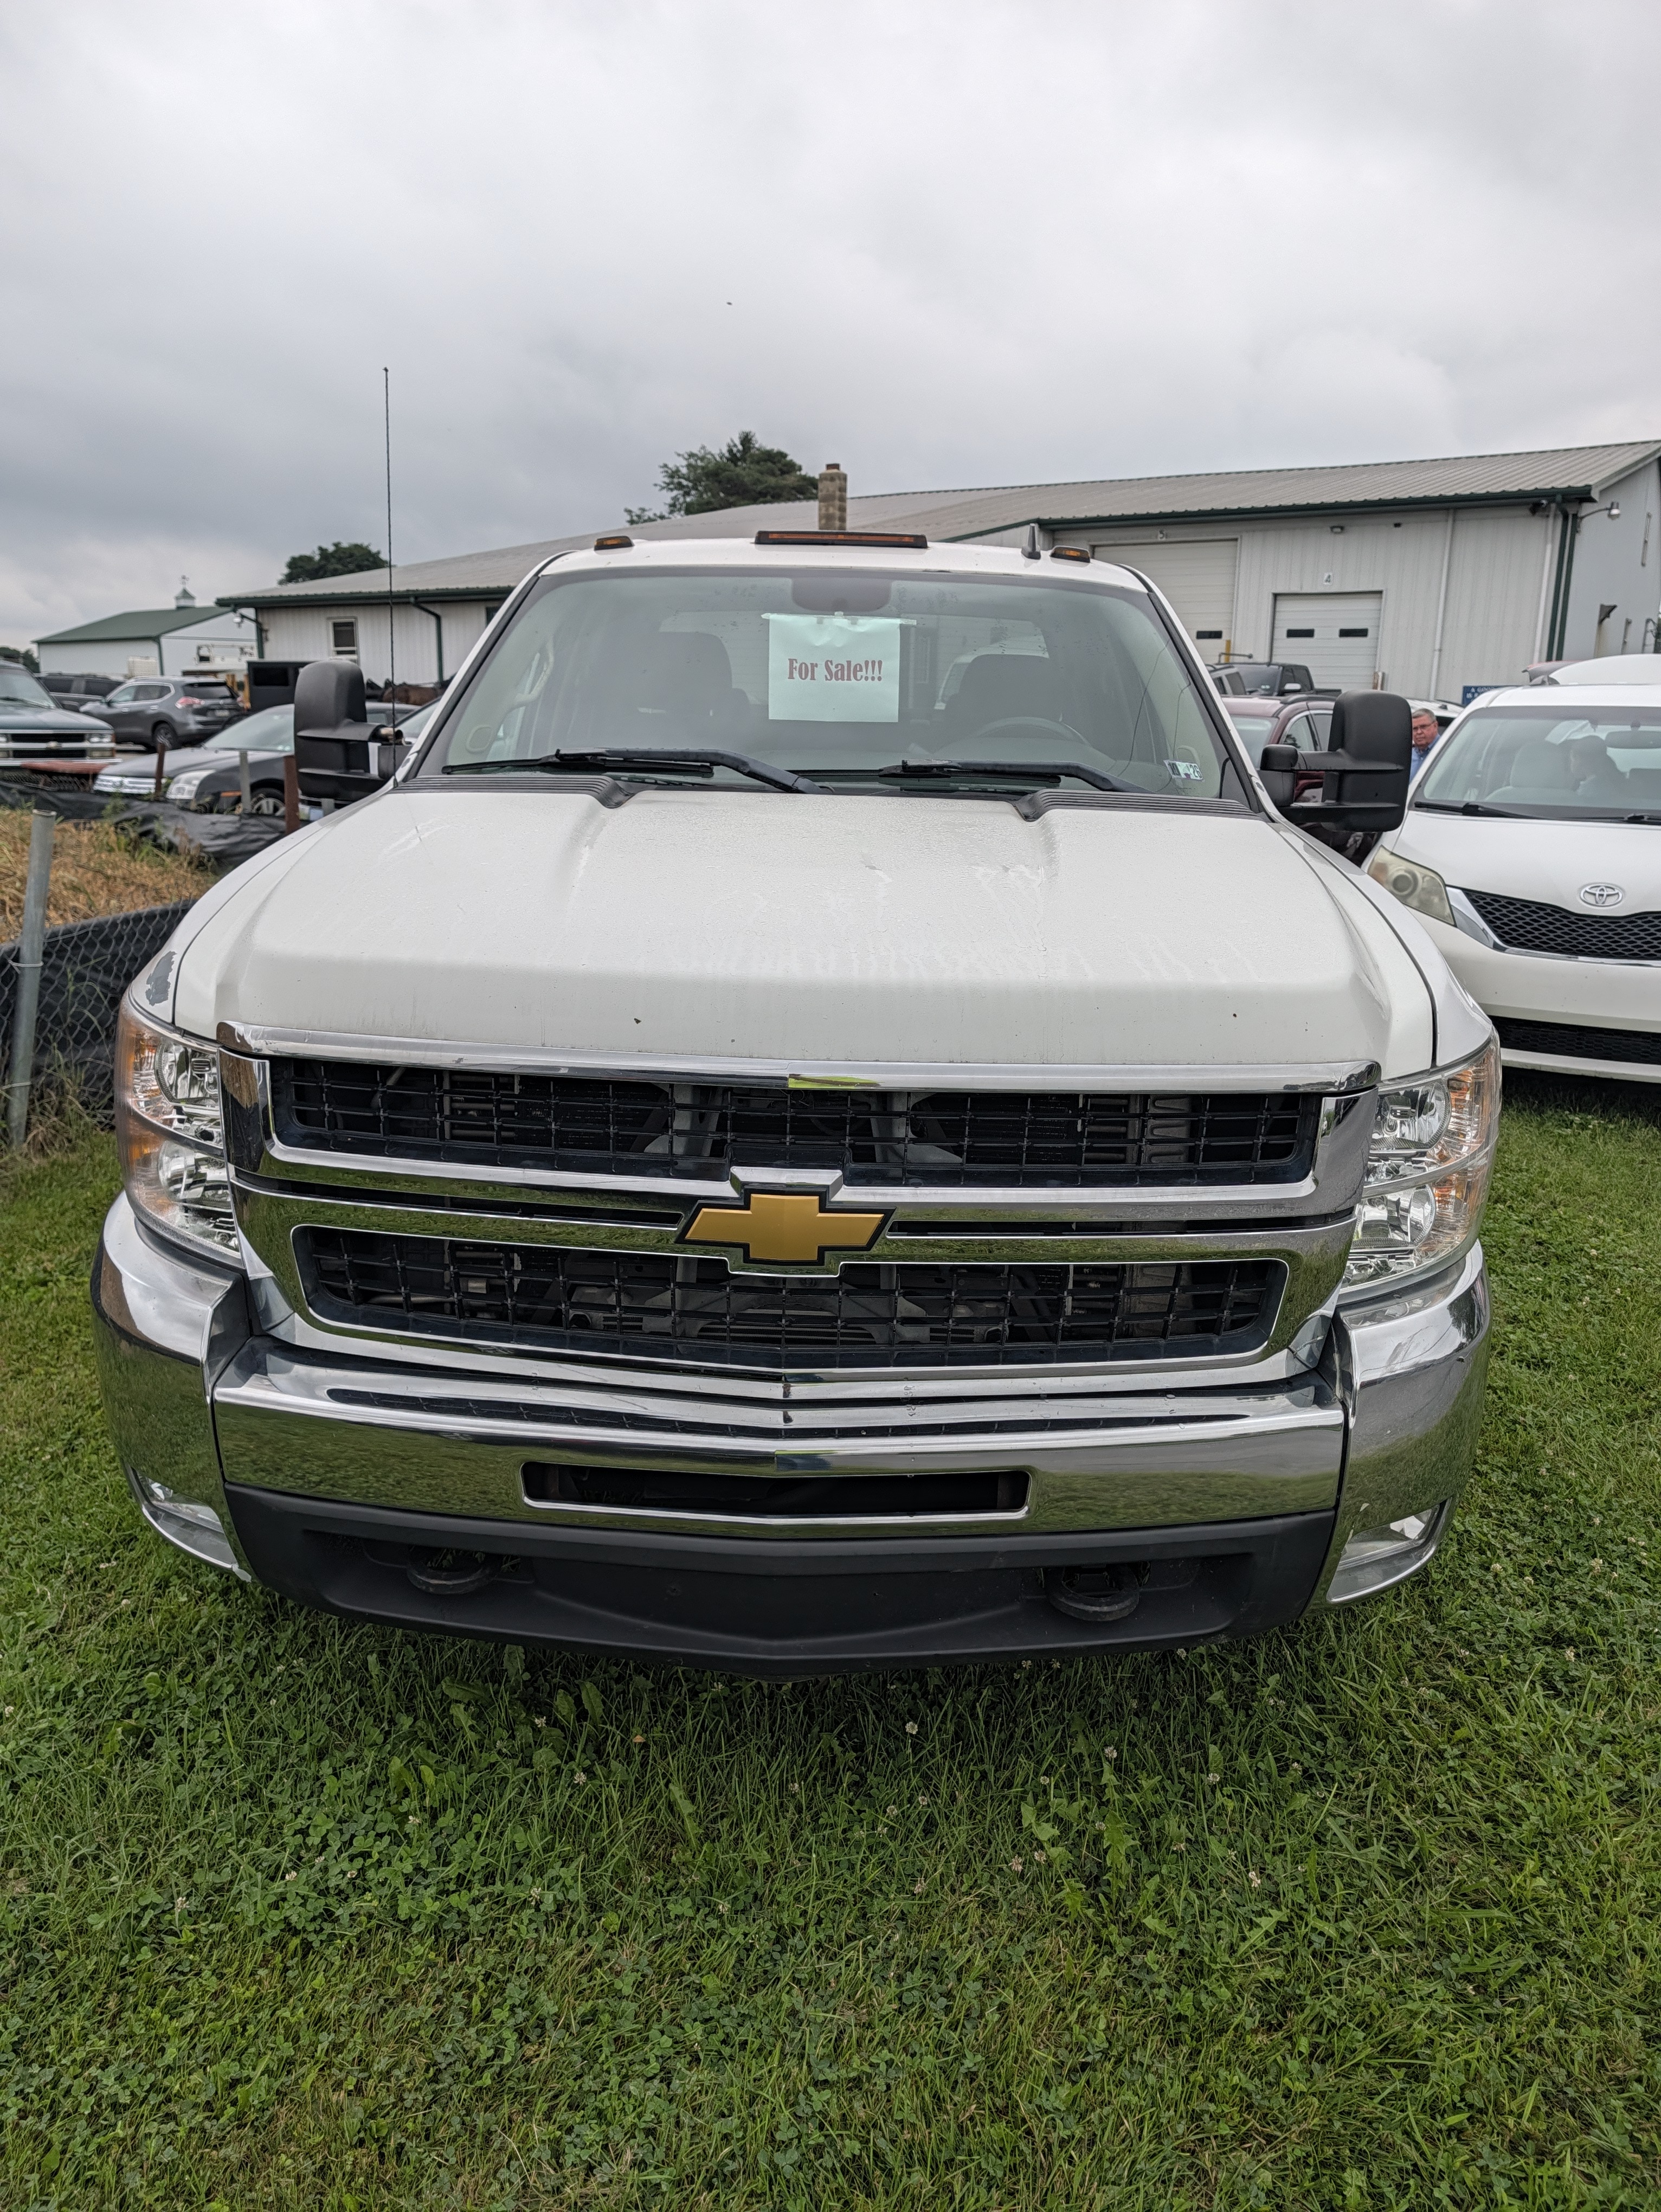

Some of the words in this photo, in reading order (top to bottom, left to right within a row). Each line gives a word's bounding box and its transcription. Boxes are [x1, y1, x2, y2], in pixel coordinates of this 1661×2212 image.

[788, 658, 818, 680] For
[824, 659, 883, 681] Sale!!!
[1189, 764, 1202, 779] 26
